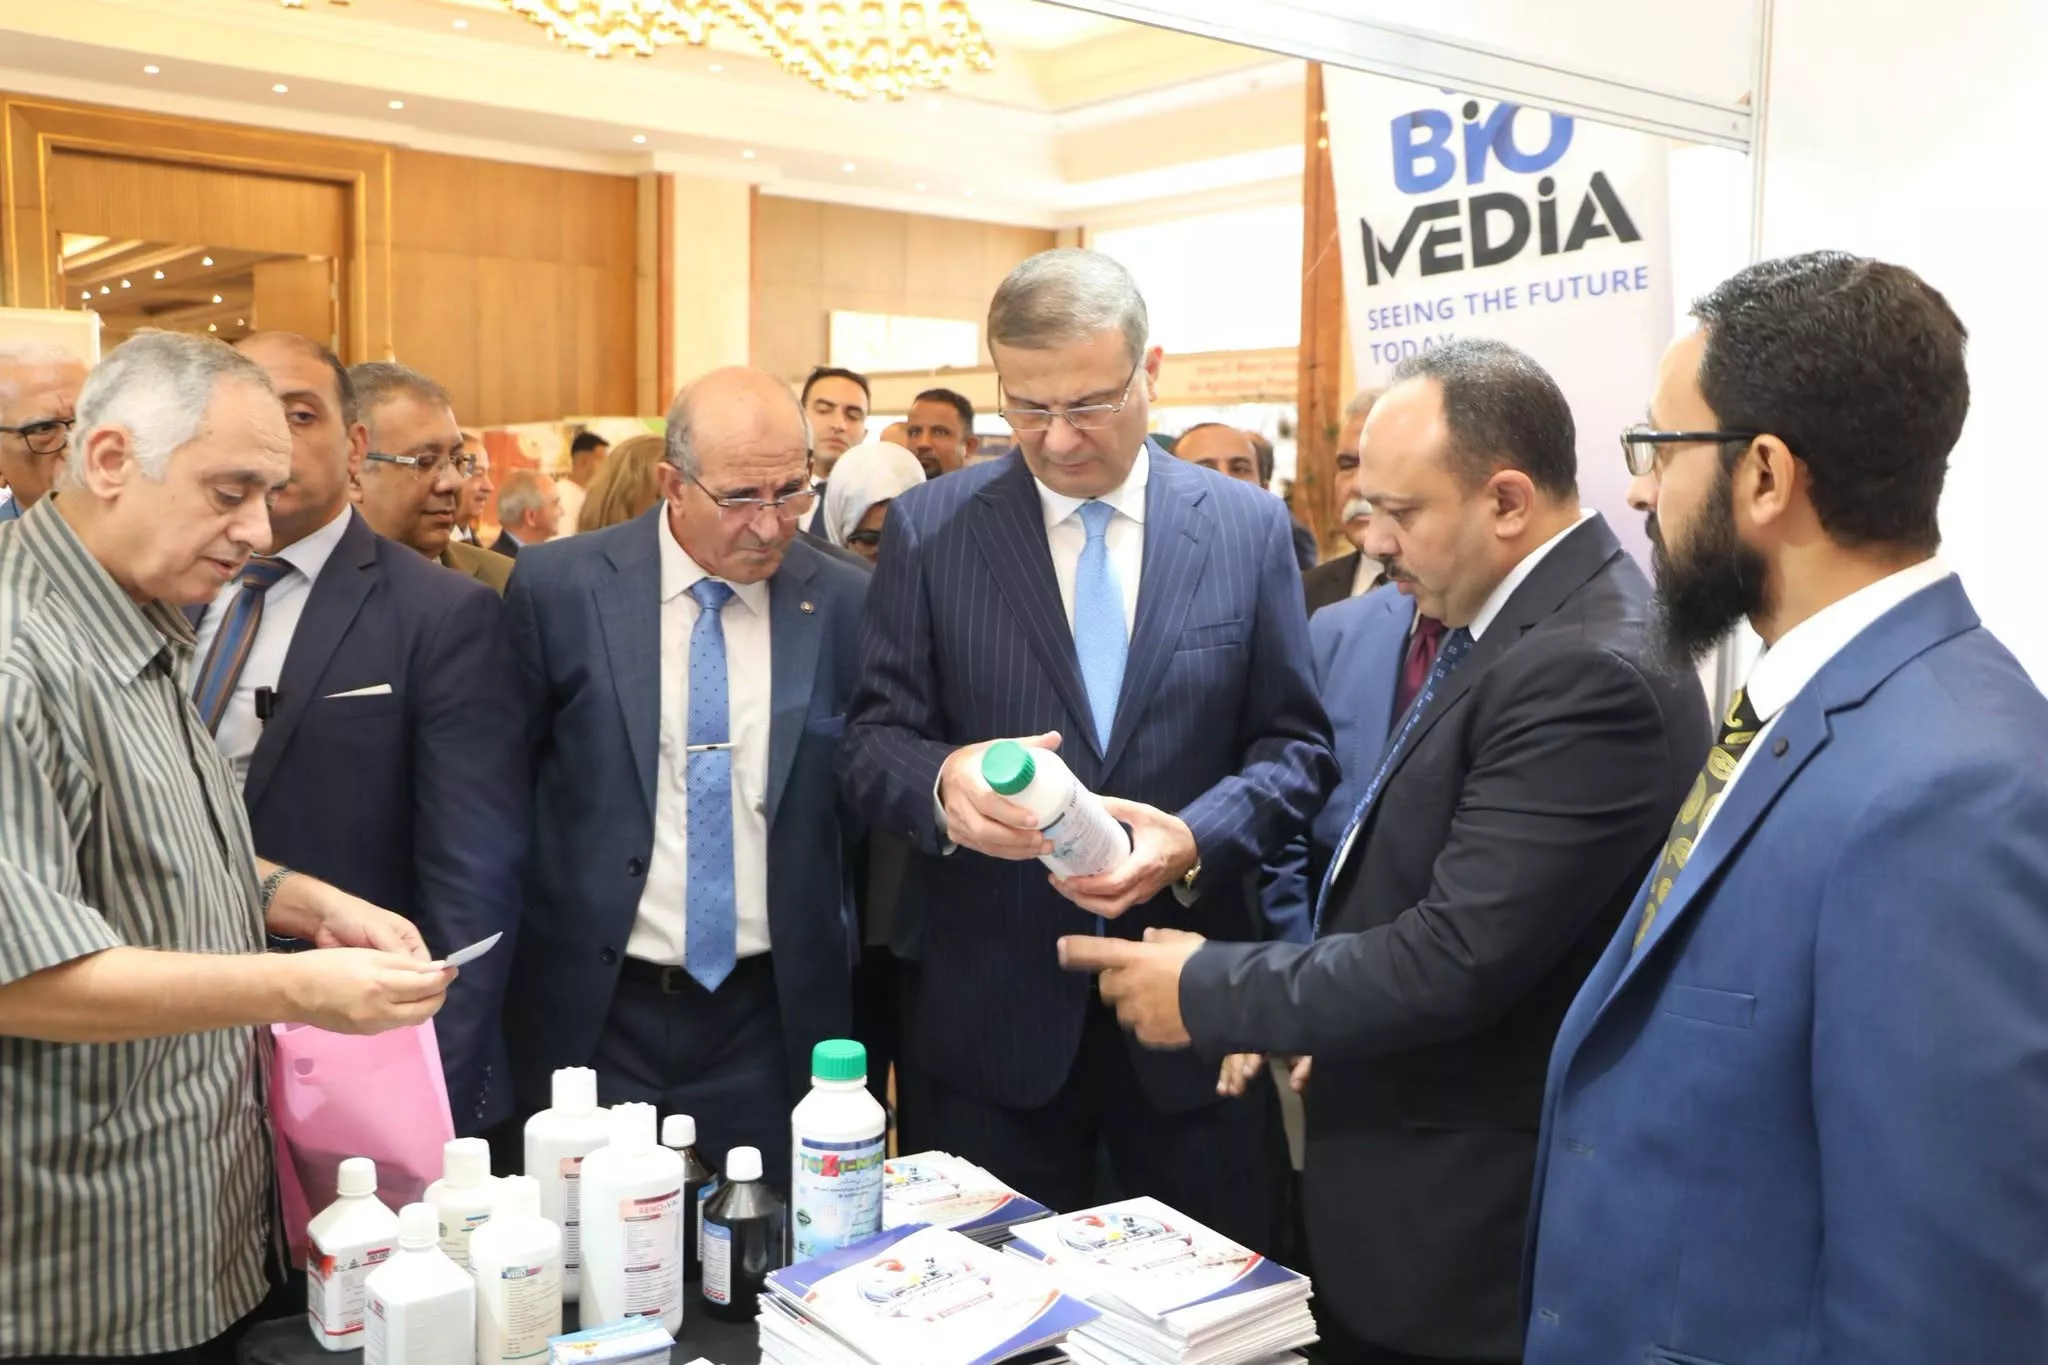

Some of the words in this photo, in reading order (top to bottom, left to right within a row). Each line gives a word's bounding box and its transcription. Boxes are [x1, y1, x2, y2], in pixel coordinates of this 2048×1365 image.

[1368, 297, 1455, 331] SEEING
[1464, 285, 1518, 316] THE
[1528, 266, 1649, 306] FUTURE
